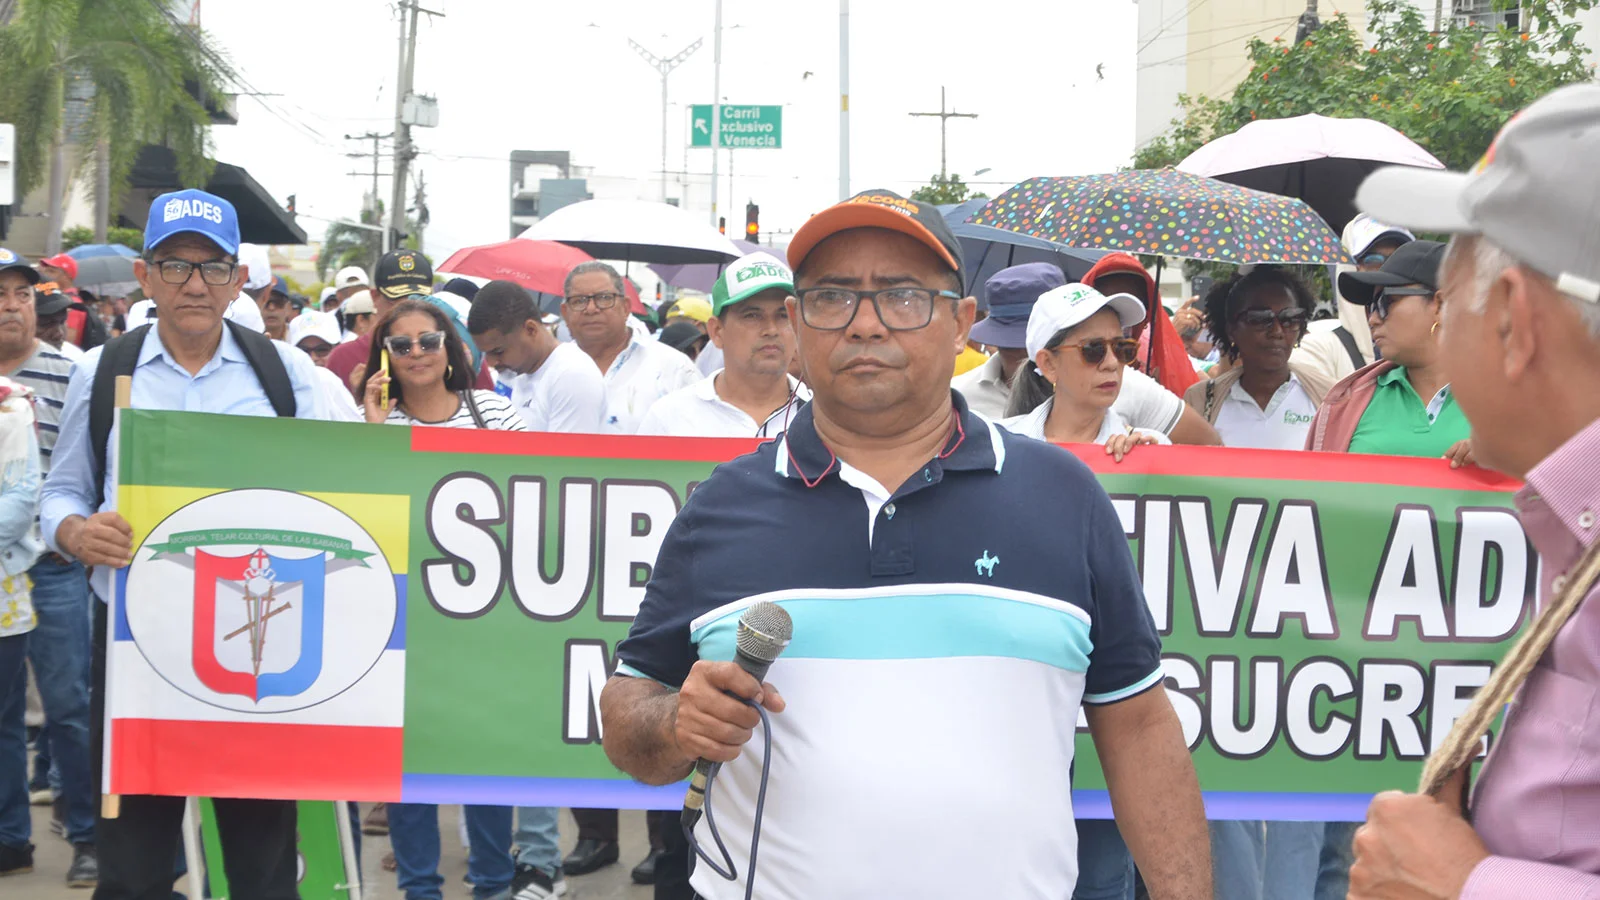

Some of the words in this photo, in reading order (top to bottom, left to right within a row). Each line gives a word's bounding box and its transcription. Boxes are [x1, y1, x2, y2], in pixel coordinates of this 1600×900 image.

[724, 106, 760, 119] Carril
[720, 121, 774, 132] xclusivo
[724, 134, 776, 146] Venecia
[181, 199, 223, 224] ADES
[170, 534, 207, 544] MORROA
[210, 532, 237, 541] TELAR
[239, 532, 280, 541] CULTURAL
[1363, 503, 1543, 643] AD
[1162, 653, 1494, 762] SUCRE
